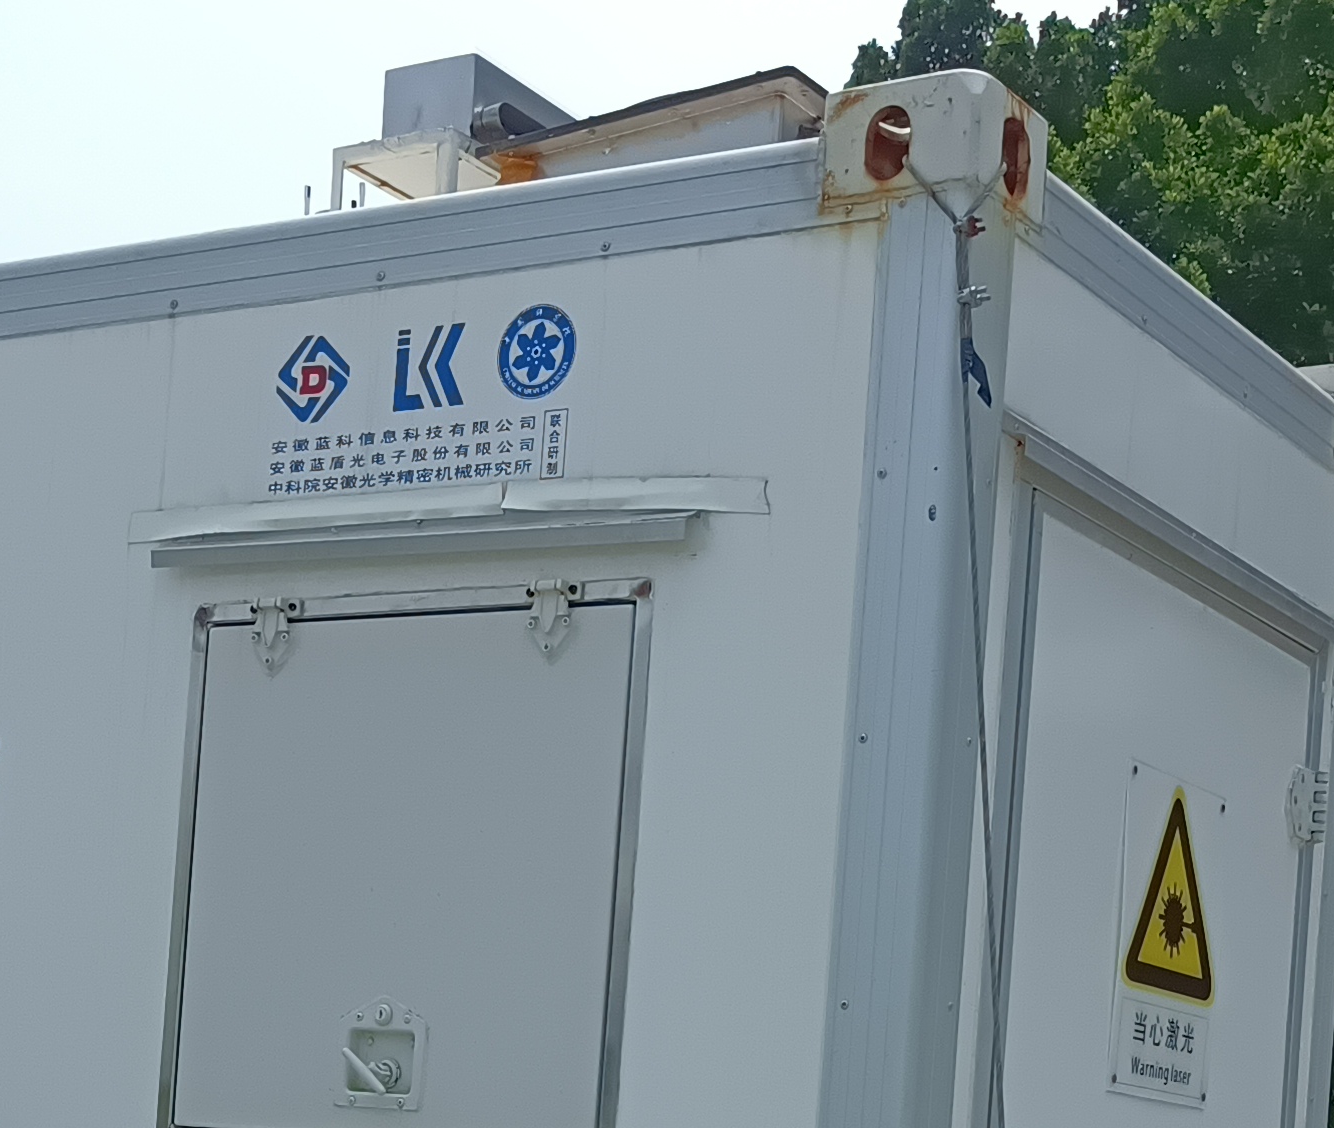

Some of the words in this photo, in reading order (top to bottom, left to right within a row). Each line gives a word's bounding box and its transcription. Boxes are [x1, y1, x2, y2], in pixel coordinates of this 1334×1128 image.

[271, 415, 536, 455] 安徽蓝科信息科技有限公司
[546, 413, 562, 475] 联合研制
[269, 437, 535, 476] 安徽蓝盾光电子股份有限公司
[268, 459, 533, 496] 中科院安徽光学精密机械研究所
[1132, 1010, 1195, 1054] 当心激光
